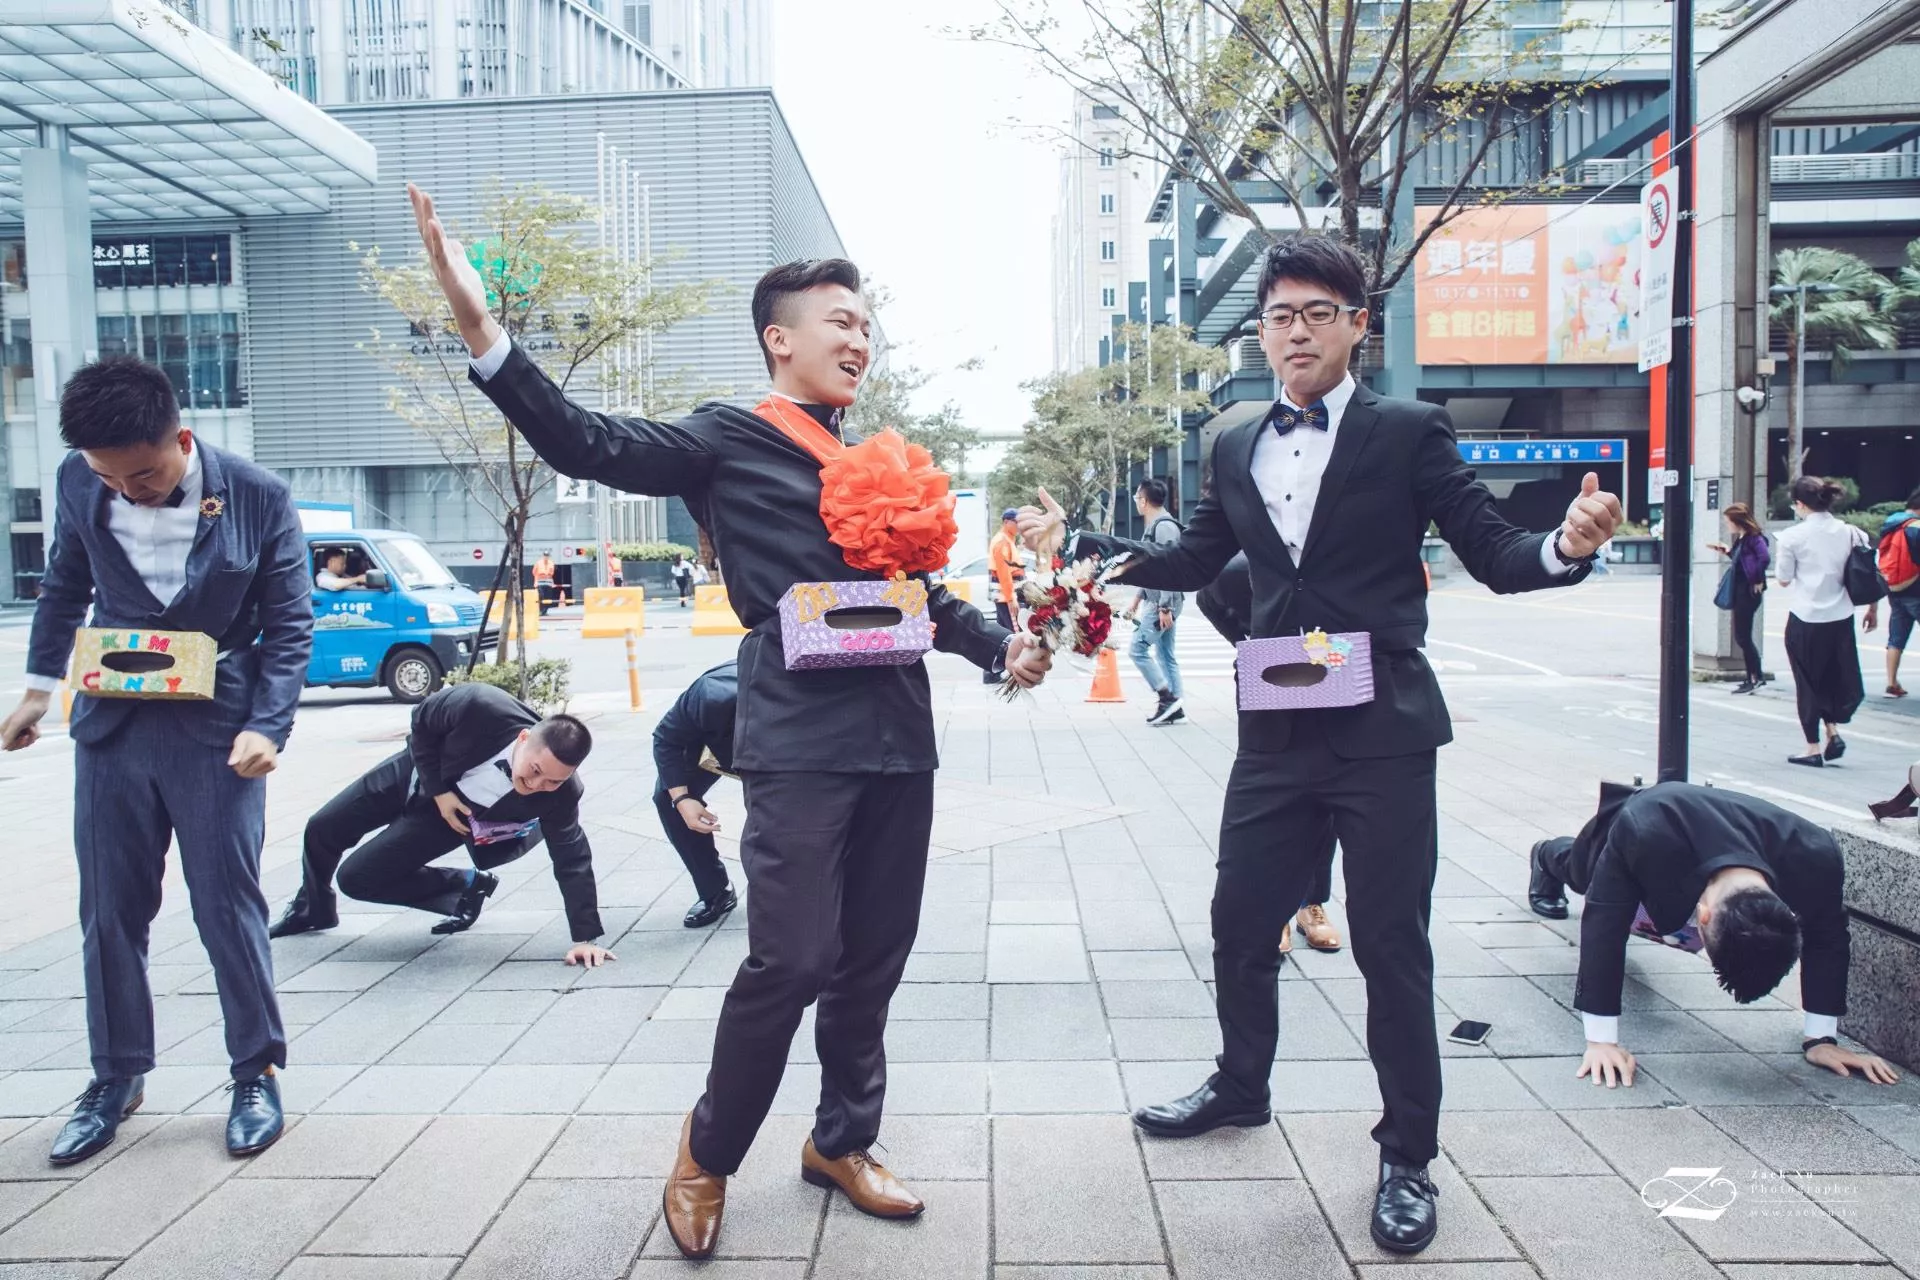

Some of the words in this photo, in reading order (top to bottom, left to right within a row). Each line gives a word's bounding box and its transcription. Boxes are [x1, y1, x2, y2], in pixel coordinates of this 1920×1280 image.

[1428, 240, 1535, 275] 週年慶
[411, 344, 472, 356] CATHA
[1472, 449, 1500, 459] 出口
[101, 632, 171, 652] KIM
